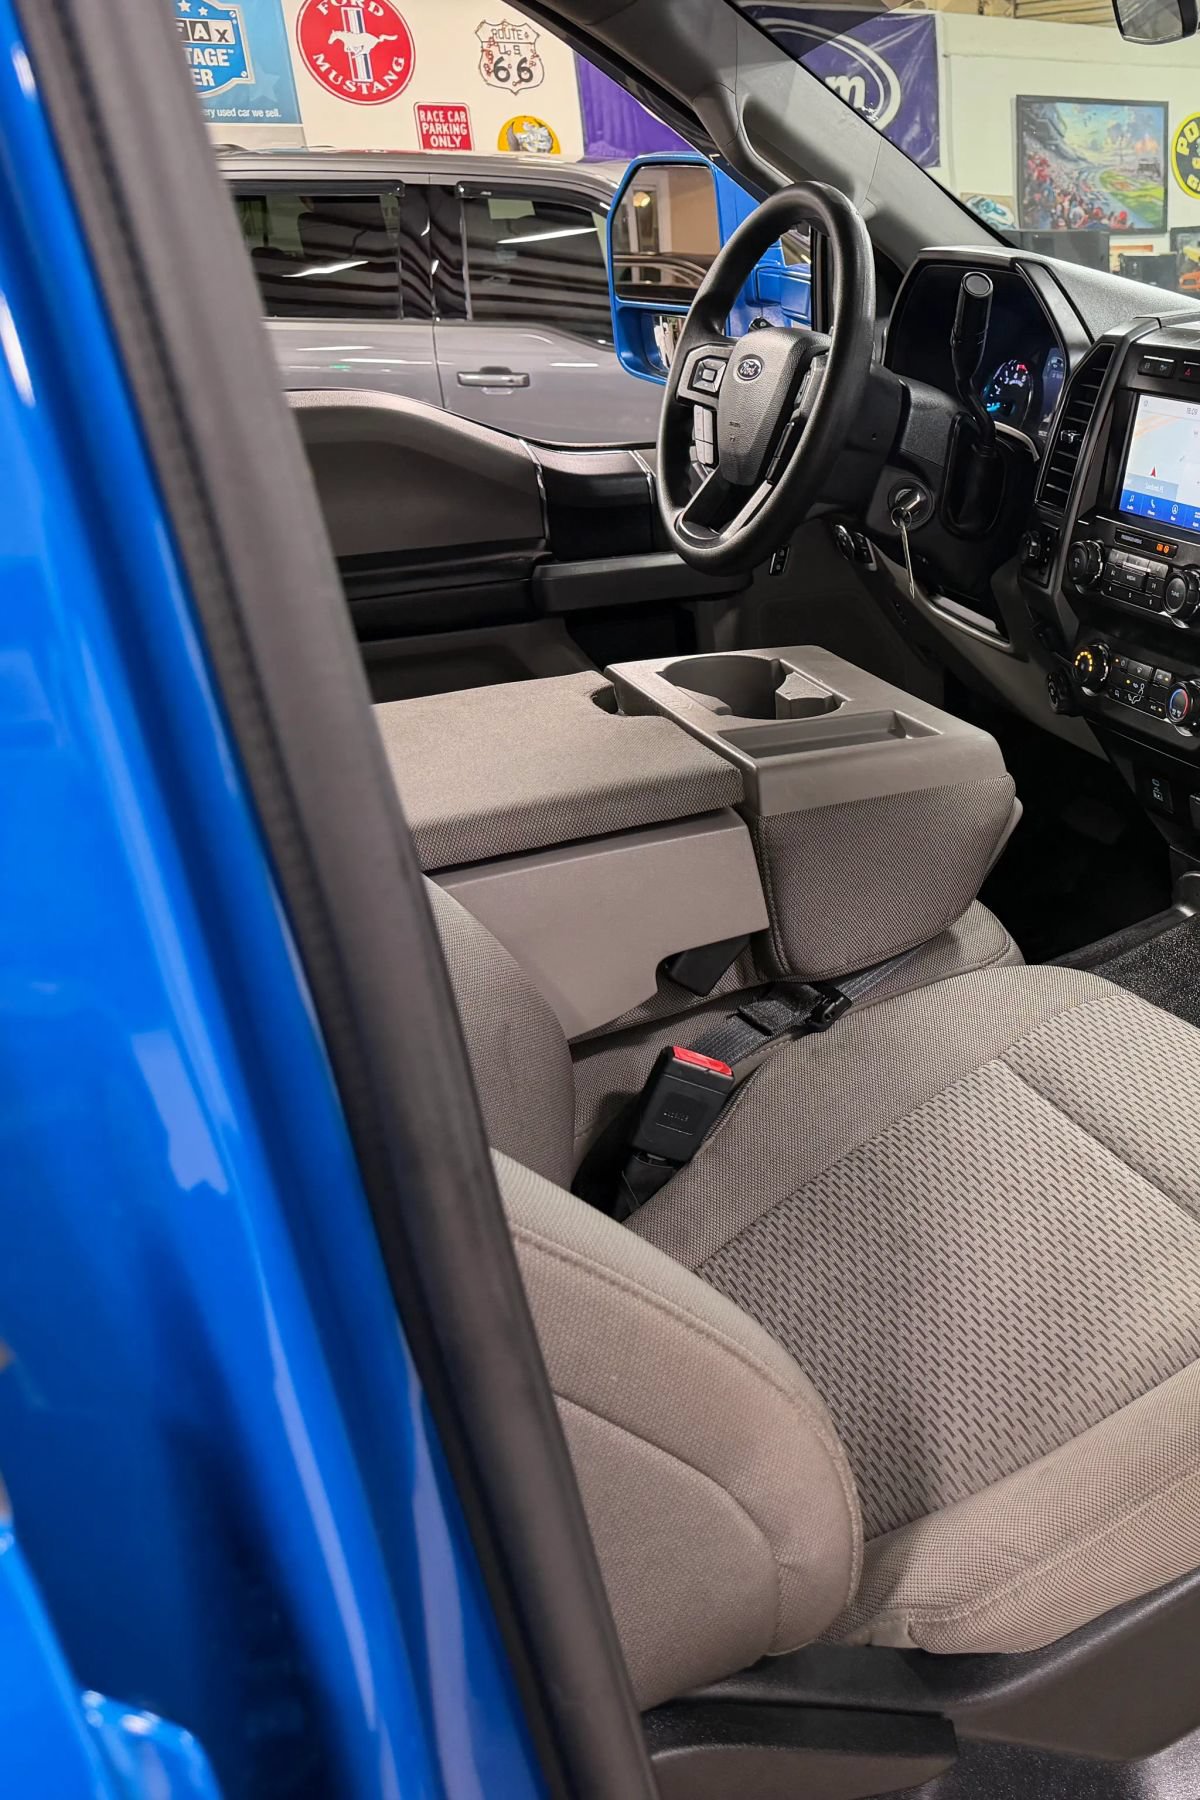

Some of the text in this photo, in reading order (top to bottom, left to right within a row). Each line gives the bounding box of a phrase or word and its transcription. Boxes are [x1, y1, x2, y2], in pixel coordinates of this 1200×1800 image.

[491, 28, 524, 41] ROUTE
[313, 53, 405, 94] MUSTANG
[217, 108, 237, 118] used
[238, 108, 251, 118] car
[252, 109, 265, 118] we
[419, 110, 467, 123] RACE CAR
[422, 122, 468, 135] PARKING
[430, 136, 462, 148] ONLY
